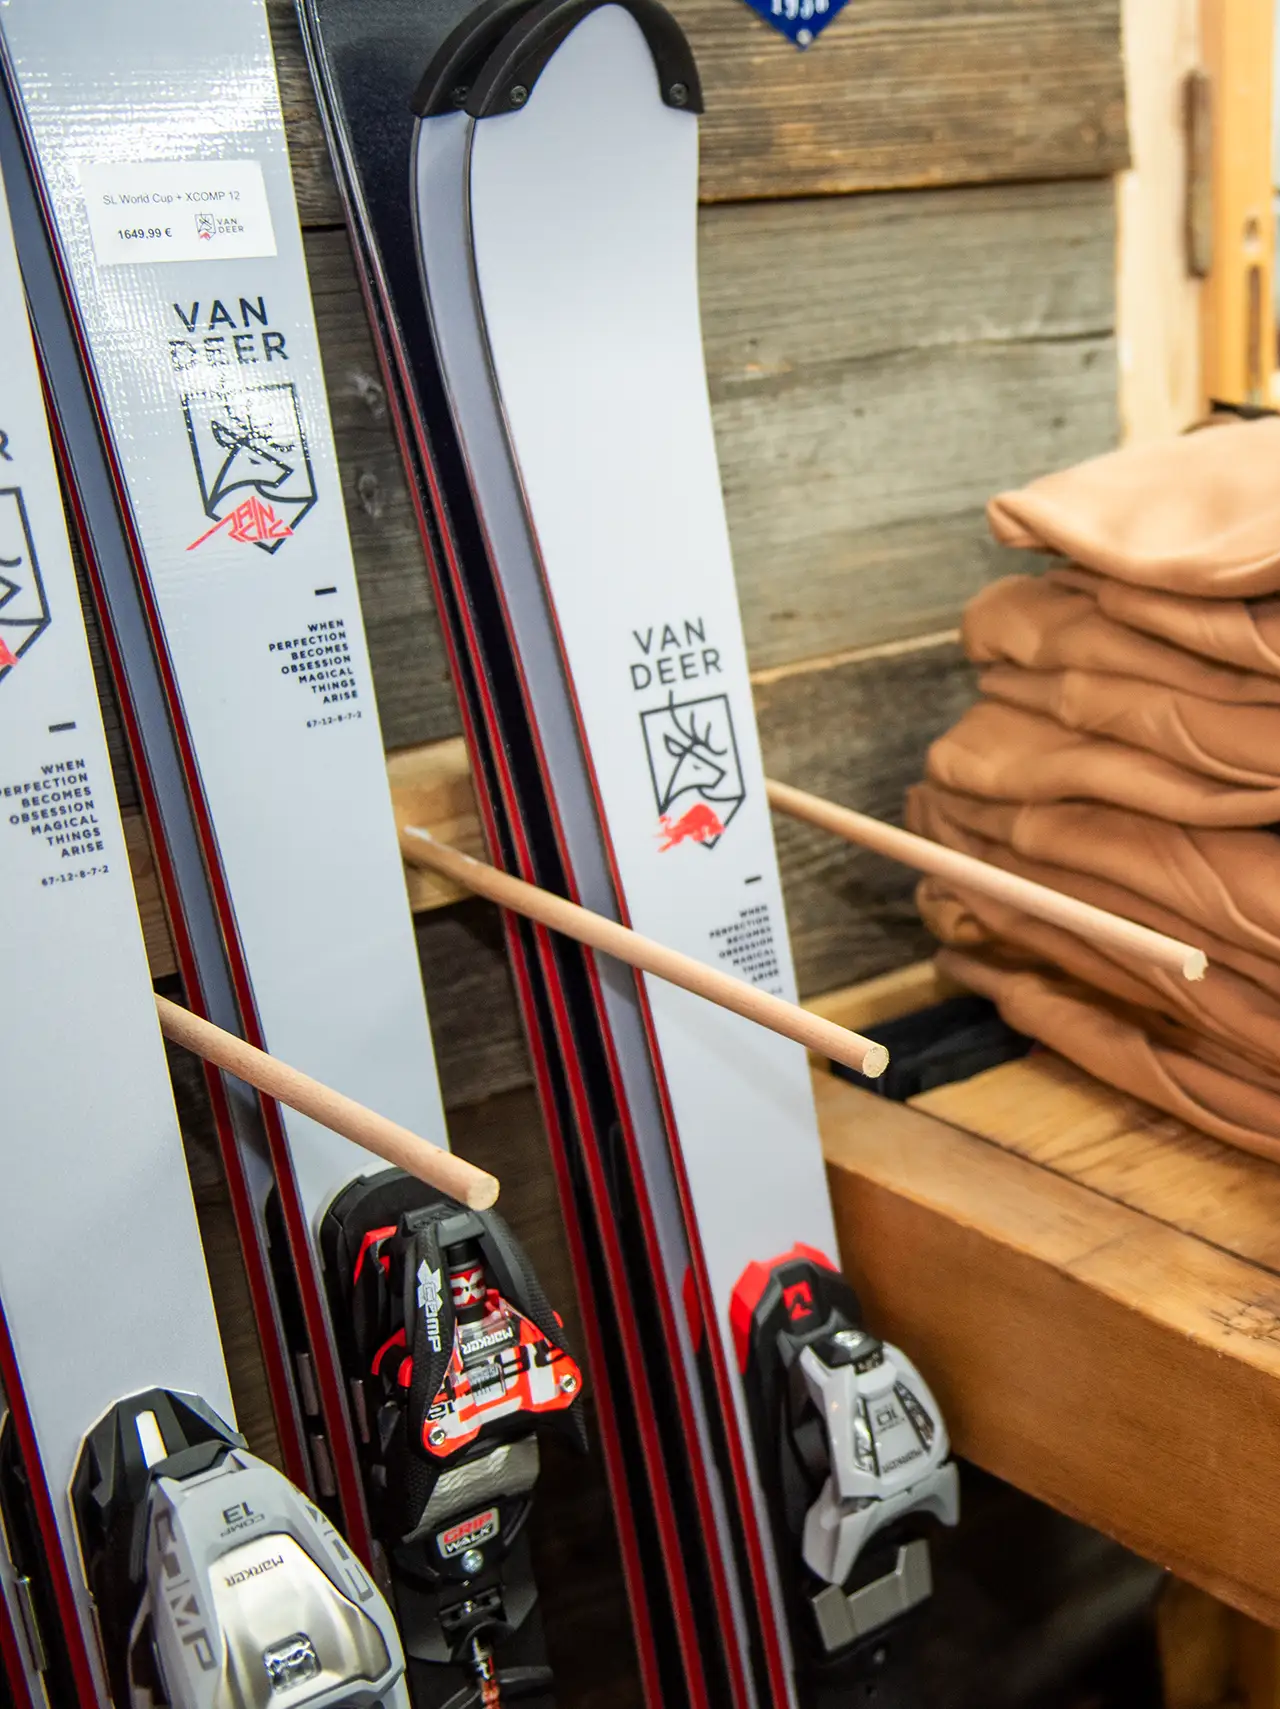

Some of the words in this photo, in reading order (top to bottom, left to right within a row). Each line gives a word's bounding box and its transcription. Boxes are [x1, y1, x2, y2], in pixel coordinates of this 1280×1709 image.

[103, 195, 117, 205] SL
[119, 194, 150, 205] World
[152, 193, 174, 205] Cup
[185, 191, 226, 202] XCOMP
[229, 190, 240, 201] 12
[118, 227, 162, 240] 1649.99
[164, 227, 173, 238] €
[218, 225, 244, 234] DEER
[173, 297, 268, 332] VAN
[168, 332, 289, 371] DEER
[308, 619, 344, 633] WHEN
[269, 631, 347, 652] PERFECTION
[632, 617, 706, 656] VAN
[291, 643, 349, 661] BECOMES
[281, 655, 351, 675] OBSESSION
[630, 648, 722, 691] DEER
[299, 667, 353, 684] MAGICAL
[311, 678, 356, 694] THINGS
[323, 690, 358, 705] ARISE
[41, 758, 86, 775] WHEN
[22, 786, 92, 809] BECOMES
[9, 800, 94, 825] OBSESSION
[31, 814, 98, 836] MAGICAL
[47, 827, 101, 847] THINGS
[61, 840, 104, 858] ARISE
[222, 1501, 254, 1524] 13
[443, 1511, 493, 1545] GRIP
[445, 1523, 492, 1553] WALK
